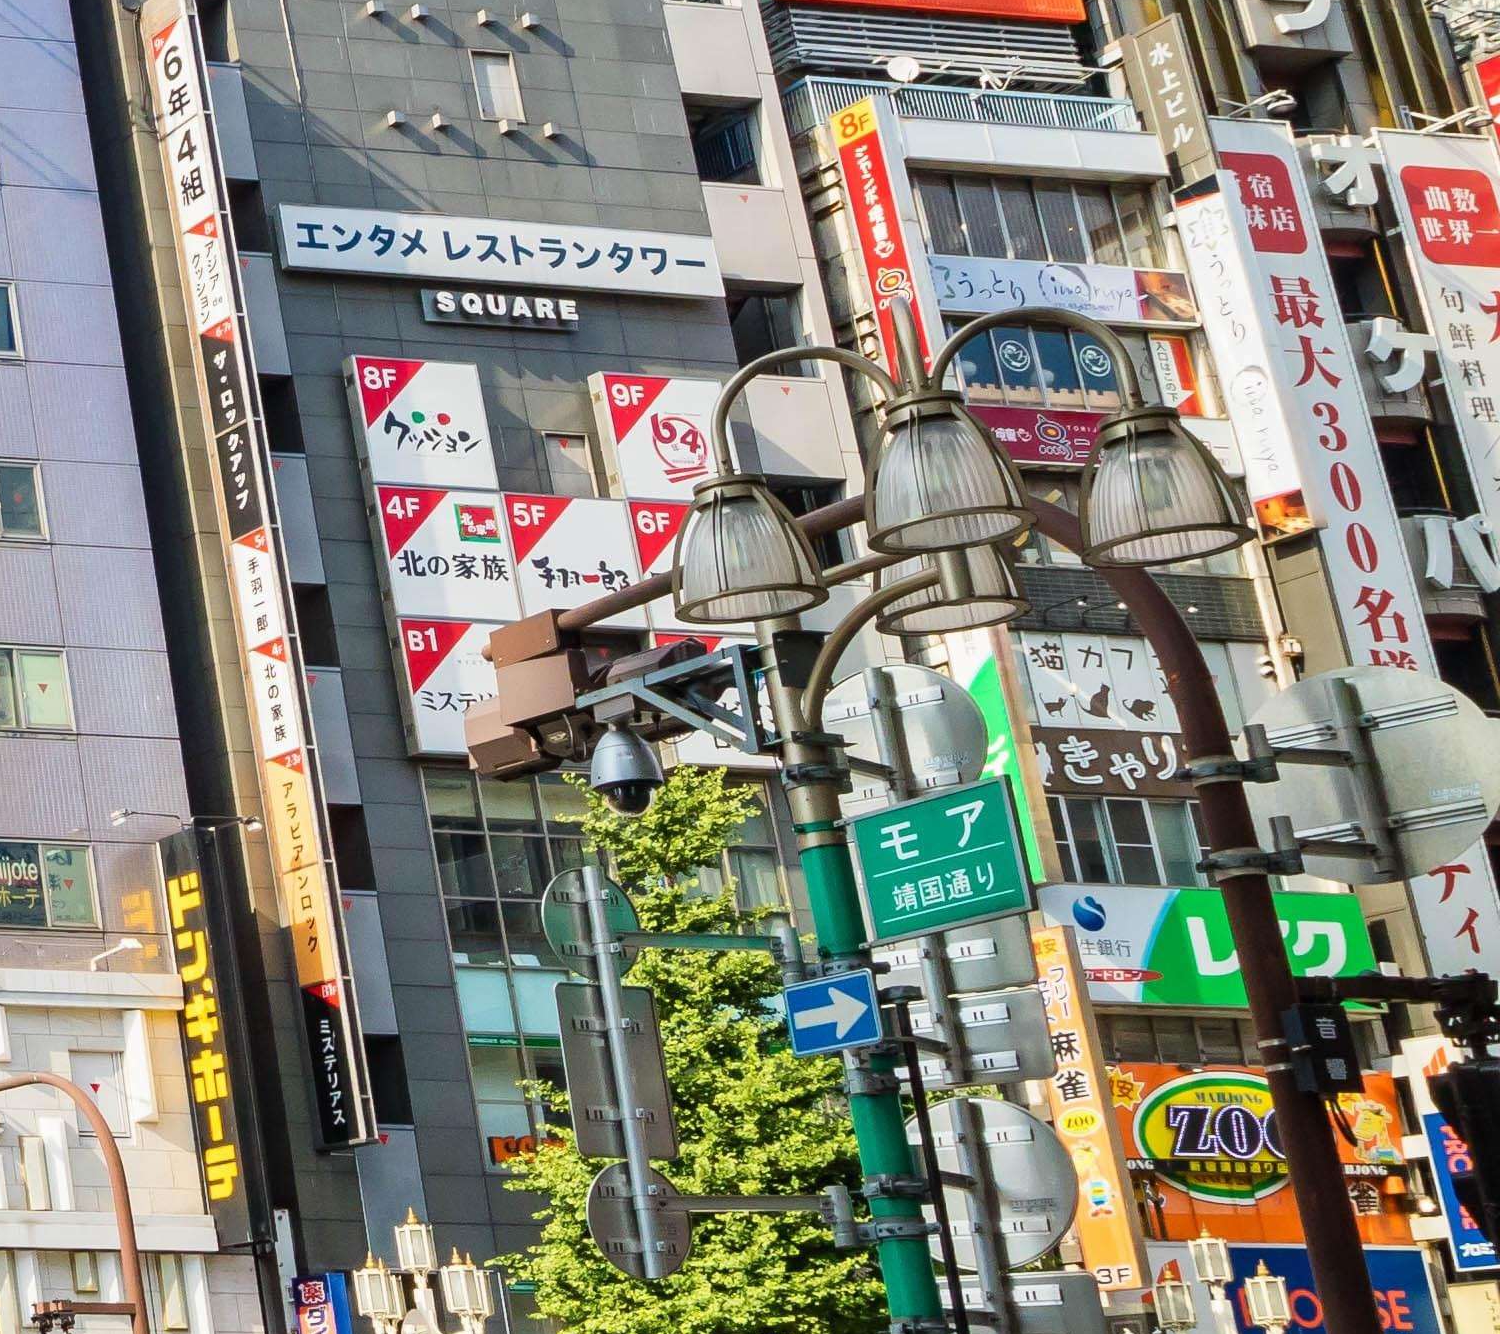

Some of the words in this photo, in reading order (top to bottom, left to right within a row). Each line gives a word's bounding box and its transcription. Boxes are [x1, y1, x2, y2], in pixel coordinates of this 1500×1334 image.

[1148, 41, 1194, 151] 水上ビル
[161, 44, 207, 208] 6年4組
[838, 110, 874, 137] 8F
[1424, 187, 1479, 214] 曲数
[296, 221, 428, 256] エンタメ
[442, 231, 706, 277] レストランタワー
[955, 272, 1025, 305] うっとり
[435, 291, 580, 322] SQUARE
[363, 366, 397, 390] 8F
[611, 383, 645, 407] 9F
[385, 496, 420, 520] 4F
[512, 502, 546, 526] 5F
[636, 510, 671, 534] 6F
[396, 552, 510, 583] 北の家族
[246, 554, 271, 634] 手羽一郎
[407, 627, 440, 653] B1
[263, 661, 289, 743] 北の家族
[880, 799, 985, 858] モア
[892, 865, 997, 912] 靖国通り
[167, 871, 239, 1202] ドン・キホーテ
[1051, 1031, 1093, 1102] 麻雀
[1095, 1266, 1131, 1285] 3F
[300, 1279, 327, 1307] 薬
